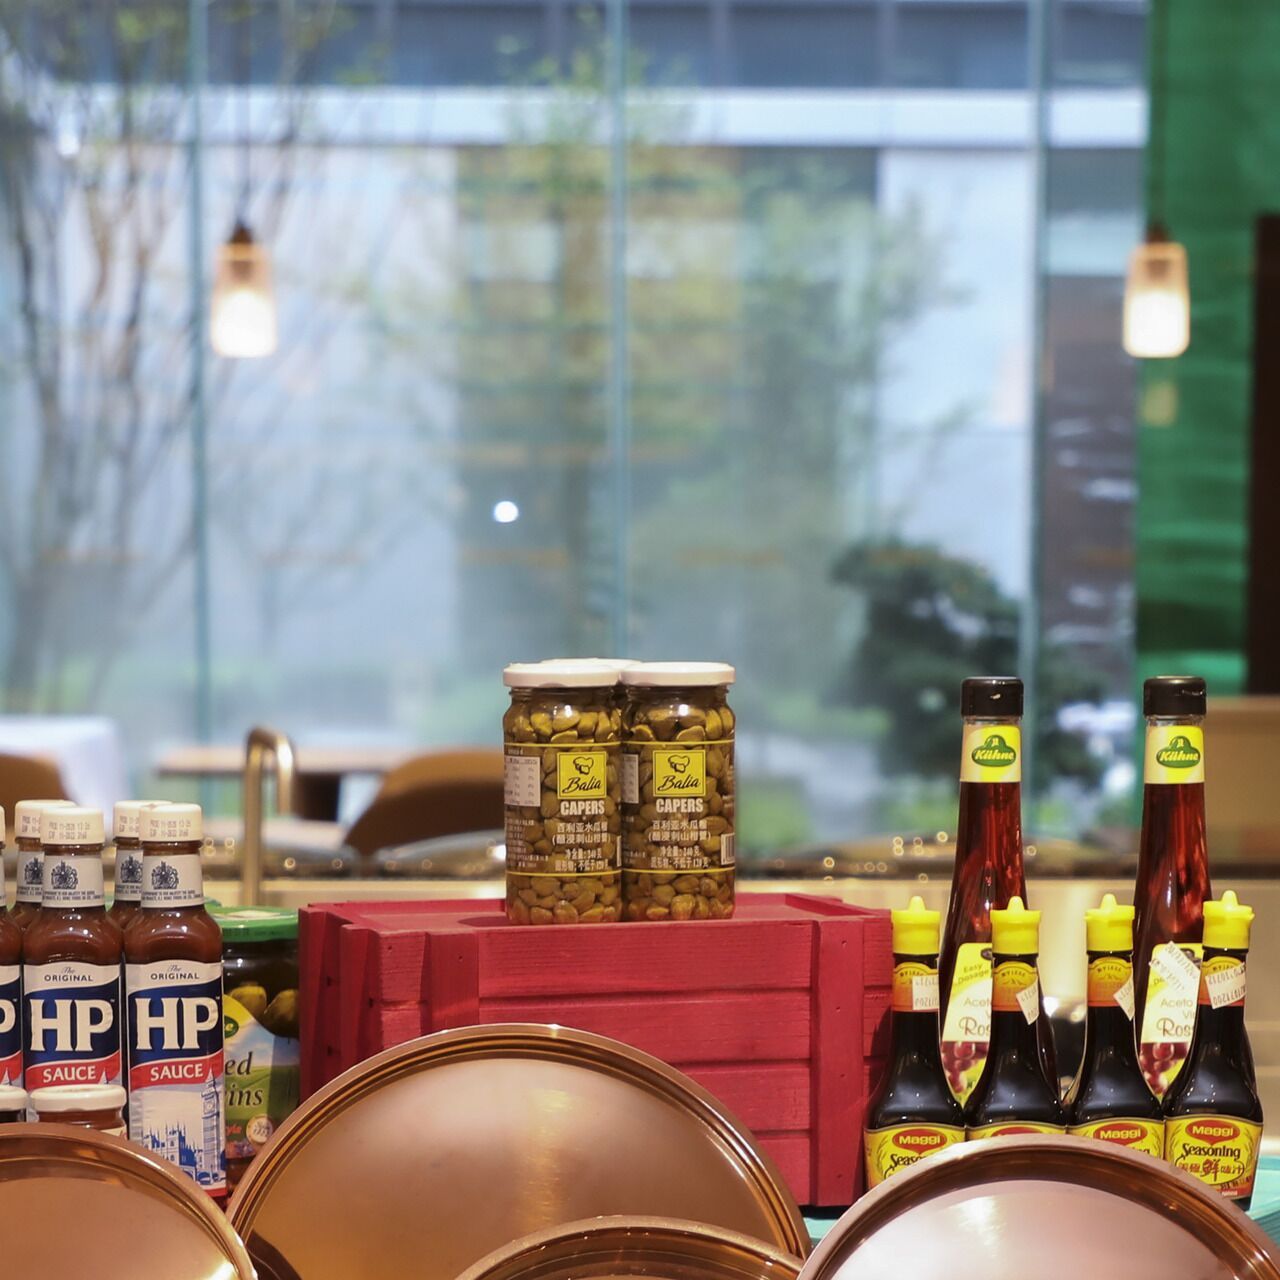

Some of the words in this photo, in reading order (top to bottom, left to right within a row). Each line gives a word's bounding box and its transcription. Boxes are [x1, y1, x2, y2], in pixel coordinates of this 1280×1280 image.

[974, 749, 1014, 760] Kühne
[1159, 751, 1199, 761] Kühne
[560, 800, 605, 816] CAPERS
[655, 798, 704, 813] CAPERS
[44, 974, 94, 982] ORIGINAL
[150, 972, 200, 980] ORIGINAL
[29, 998, 114, 1051] HP
[135, 997, 219, 1050] HP
[43, 1065, 97, 1083] SAUCE
[150, 1063, 204, 1081] SAUCE
[1100, 1127, 1142, 1139] Maggi
[1192, 1125, 1234, 1137] Maggi
[899, 1135, 941, 1146] Maggi
[1180, 1142, 1241, 1161] Seasoning
